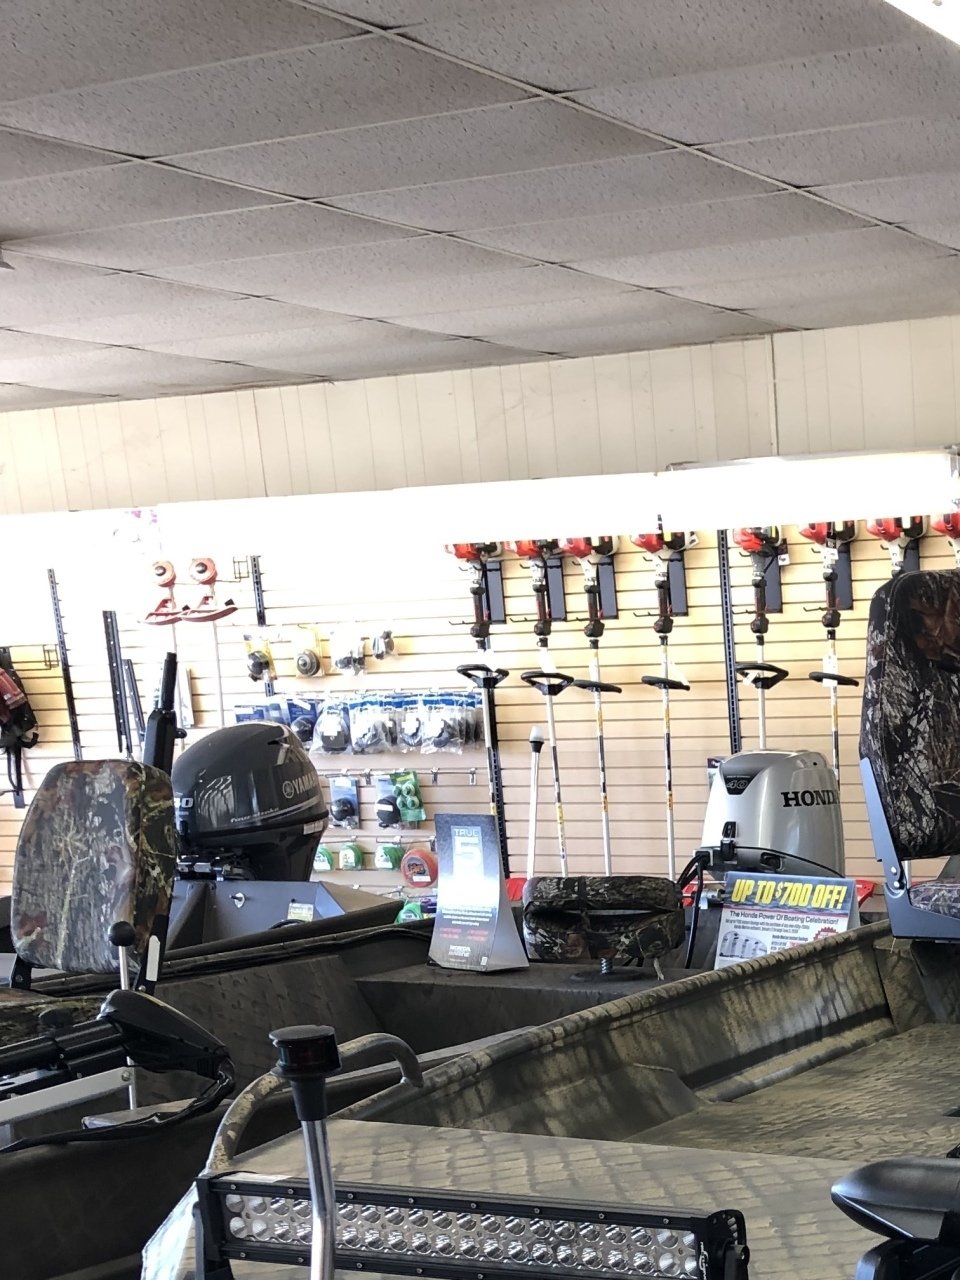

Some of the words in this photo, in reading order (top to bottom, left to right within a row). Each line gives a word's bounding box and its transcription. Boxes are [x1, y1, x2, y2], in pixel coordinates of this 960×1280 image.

[731, 879, 755, 902] UP
[755, 880, 776, 904] TO
[775, 882, 813, 907] $700
[811, 883, 847, 909] OFF!
[740, 911, 758, 919] Honda
